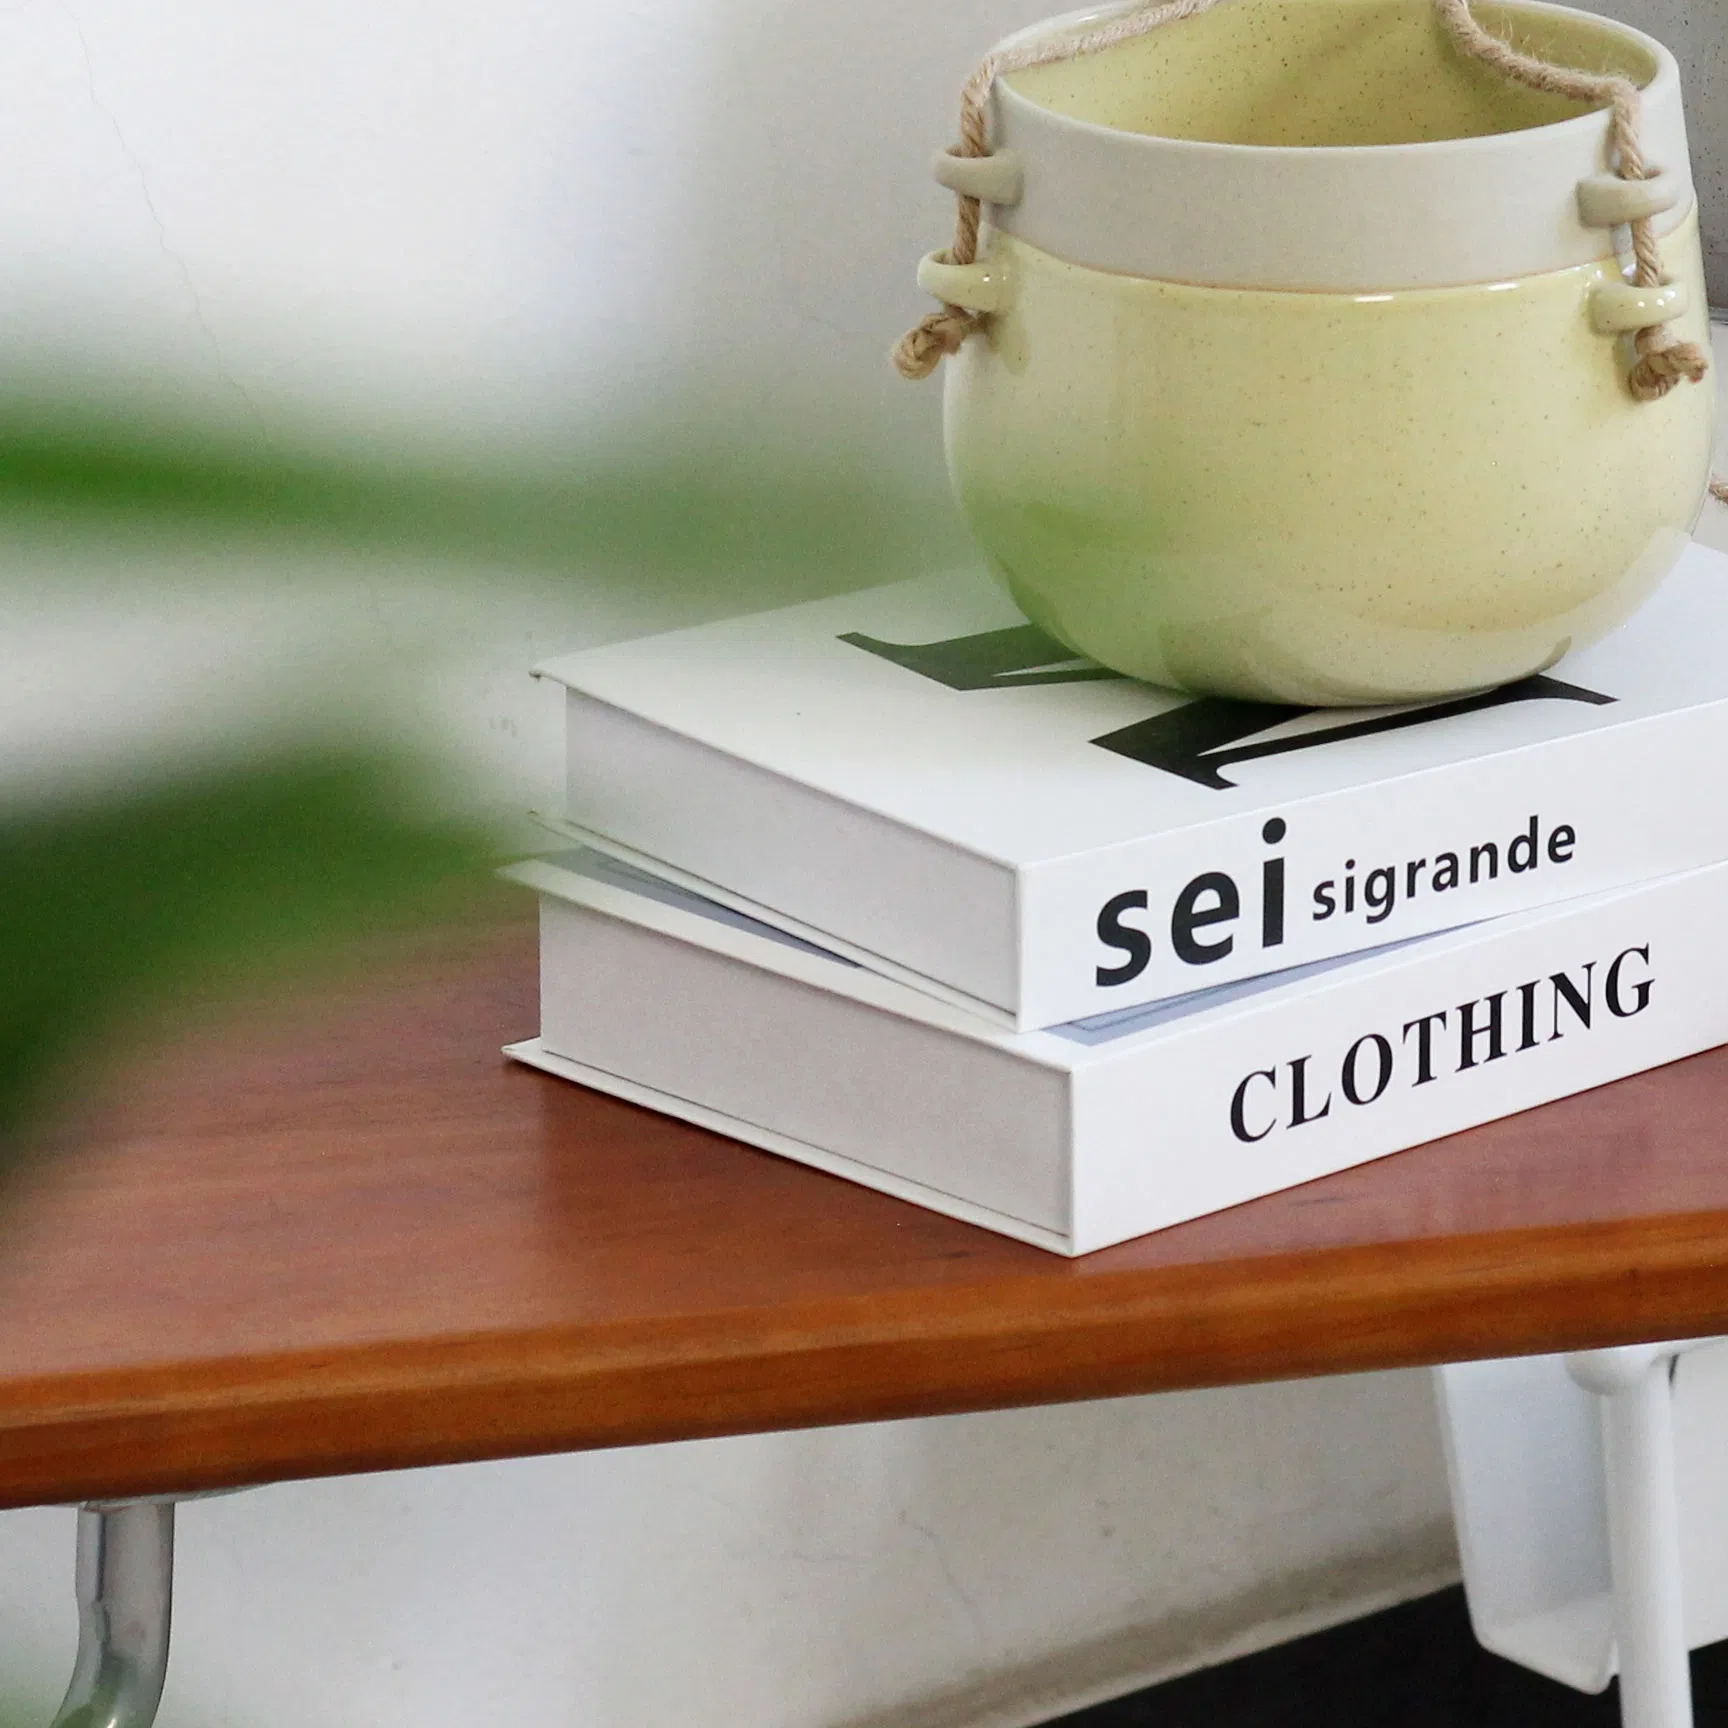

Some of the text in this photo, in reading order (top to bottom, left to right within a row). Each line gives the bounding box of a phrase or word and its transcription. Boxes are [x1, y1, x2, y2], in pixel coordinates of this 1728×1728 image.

[1095, 814, 1578, 988] sei sigrande
[1228, 943, 1656, 1144] CLOTHING
